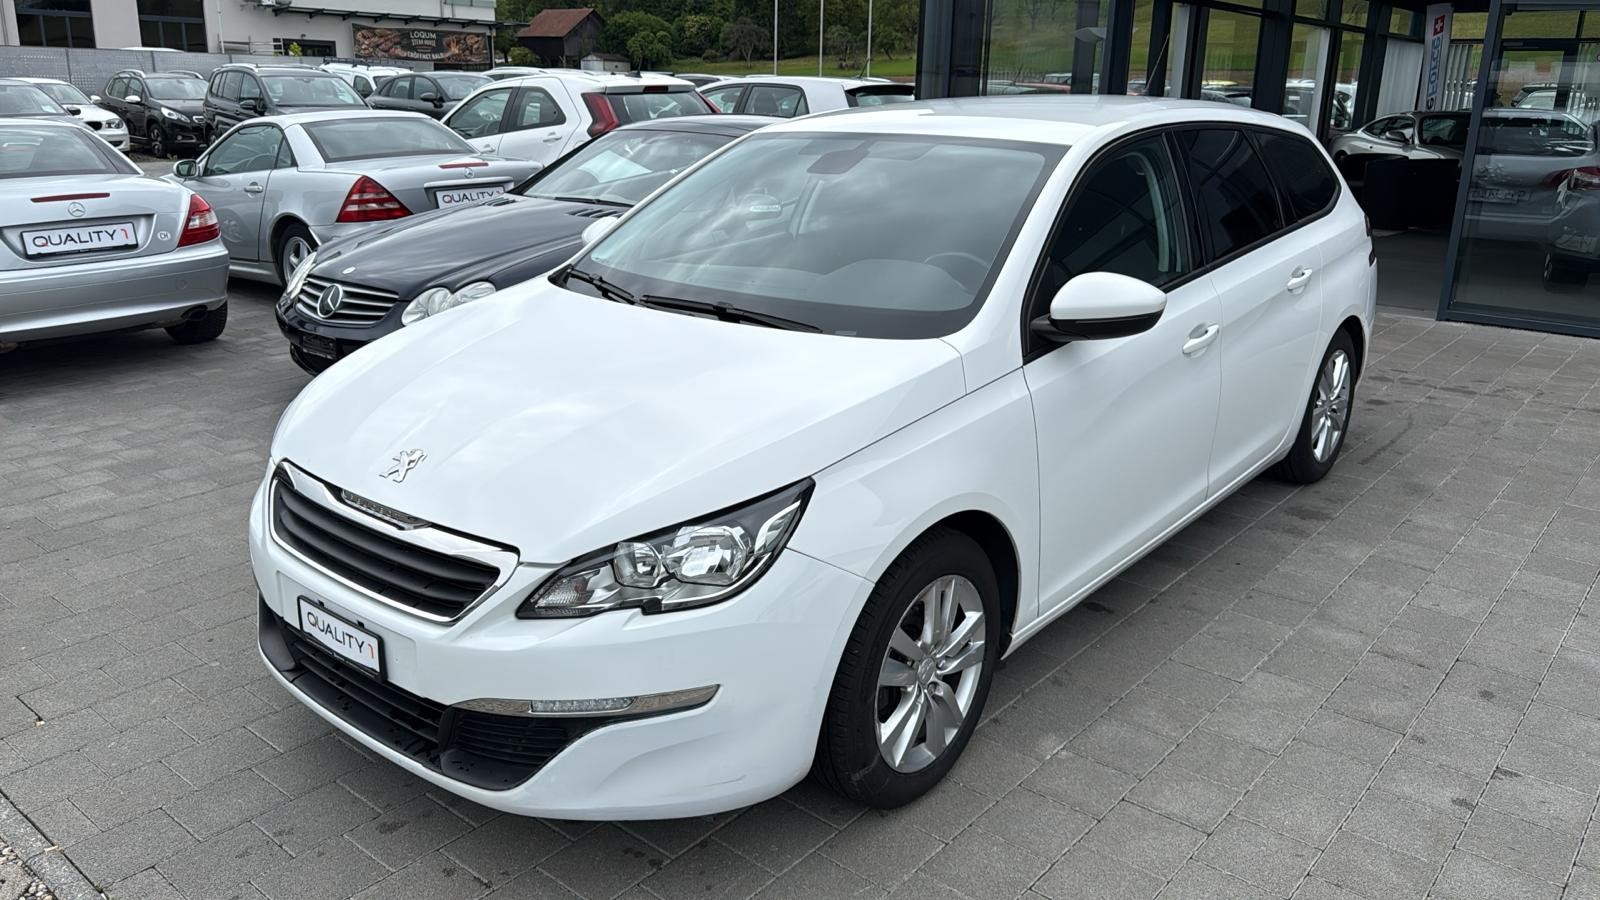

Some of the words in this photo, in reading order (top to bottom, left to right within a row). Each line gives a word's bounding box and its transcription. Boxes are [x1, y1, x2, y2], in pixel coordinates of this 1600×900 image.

[409, 31, 437, 40] LOQUM
[32, 229, 117, 247] QUALITY
[120, 228, 129, 240] 1
[307, 611, 365, 653] QUALITY
[368, 642, 375, 659] 1
